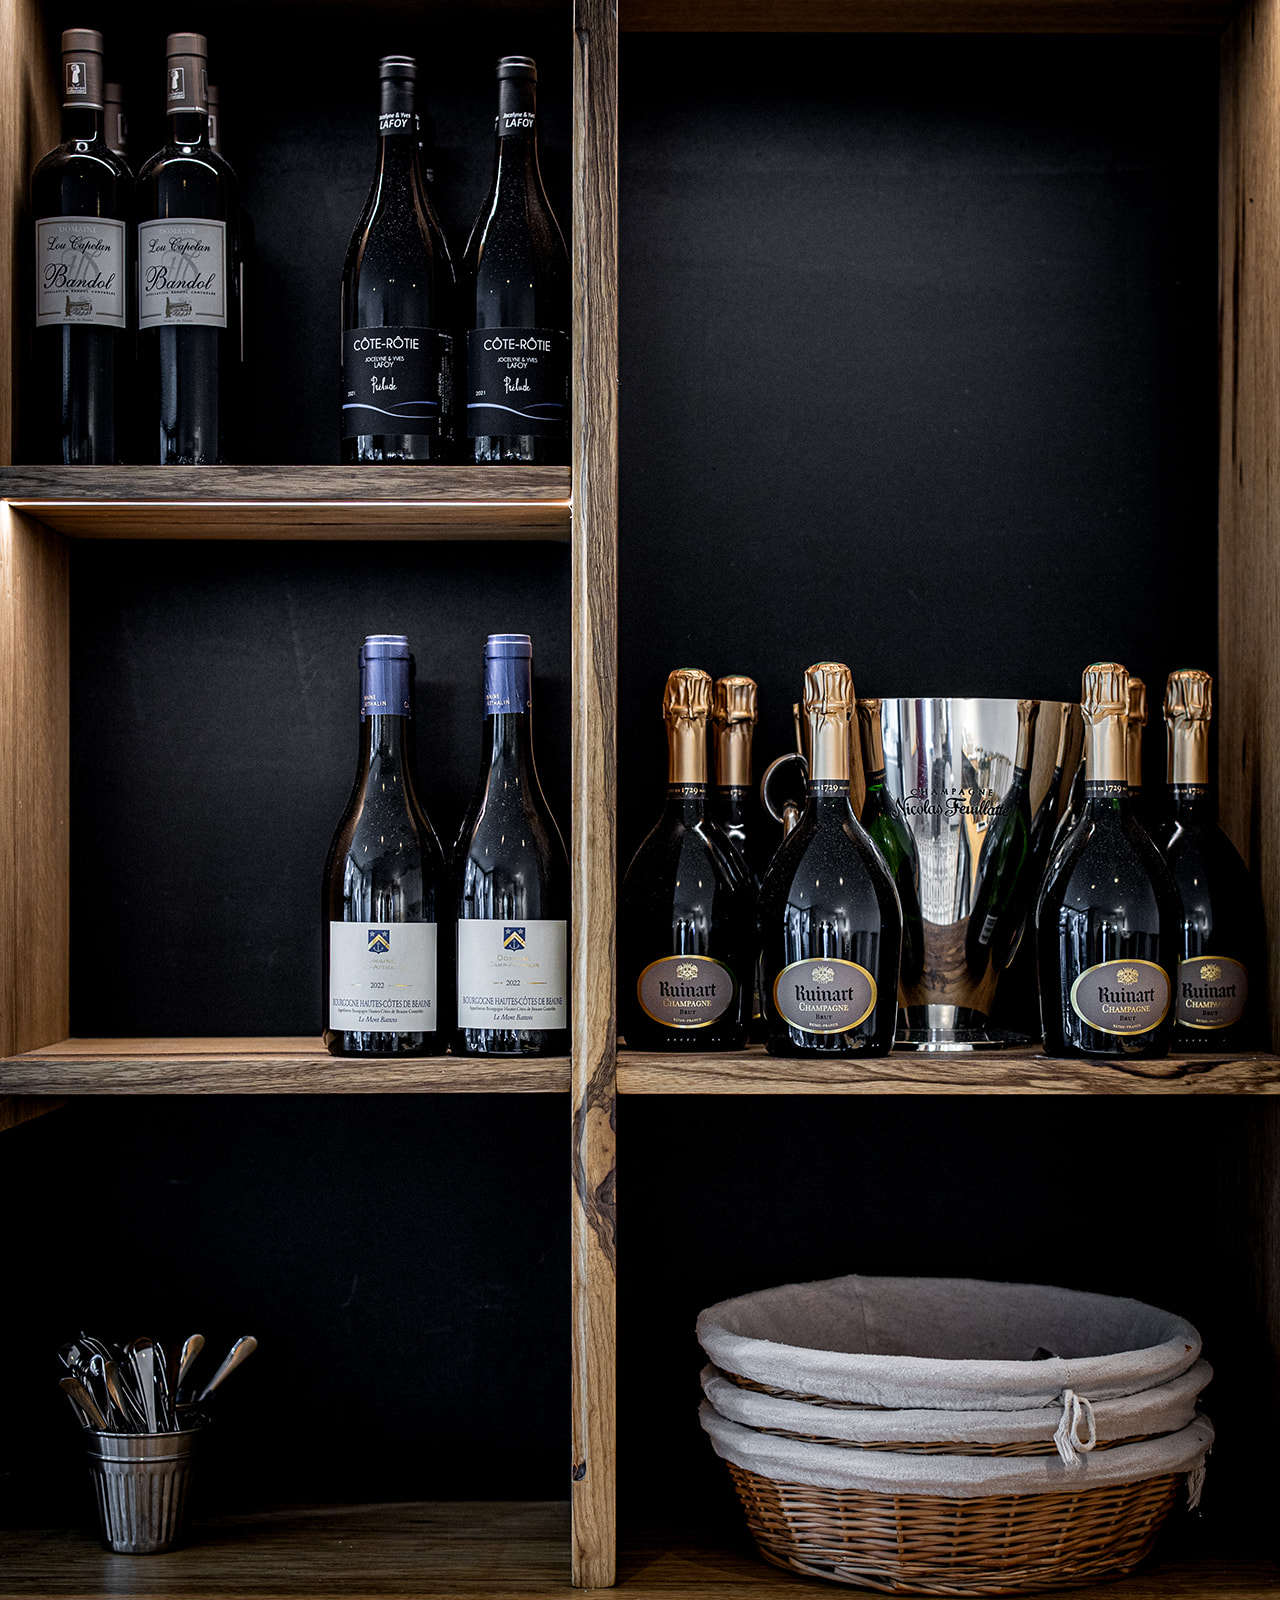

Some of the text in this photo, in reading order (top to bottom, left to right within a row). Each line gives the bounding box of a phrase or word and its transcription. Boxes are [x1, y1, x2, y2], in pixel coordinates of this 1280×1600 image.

[380, 119, 408, 130] LAFOY
[505, 118, 534, 128] LAFOY
[60, 226, 97, 234] DOMAINE
[160, 227, 196, 235] DOMAINE
[47, 236, 66, 251] Lou
[148, 238, 166, 253] Lou
[43, 263, 116, 289] Bandol
[145, 265, 216, 292] Bandol
[353, 335, 420, 351] CÔTE-RÔTIE
[483, 337, 551, 352] CÔTE-RÔTIE
[374, 361, 395, 369] LAFOY
[681, 787, 699, 795] 1729
[821, 784, 839, 793] 1729
[910, 788, 993, 797] CHAMPAGNE
[1105, 785, 1122, 793] 1729
[890, 795, 943, 819] Nicolas
[659, 981, 717, 997] Ruinart
[795, 984, 854, 1002] Ruinart
[1098, 986, 1155, 1003] Ruinart
[1182, 982, 1236, 999] Ruinart
[360, 998, 402, 1008] HAUTES-CÔTES
[403, 999, 411, 1008] DE
[412, 999, 431, 1008] BEAUNE
[462, 995, 563, 1006] BOURGOGNE HAUTES-CÔTES DE BEAUNE
[663, 998, 712, 1008] CHAMPAGNE
[799, 1002, 849, 1012] CHAMPAGNE
[1102, 1004, 1151, 1014] CHAMPAGNE
